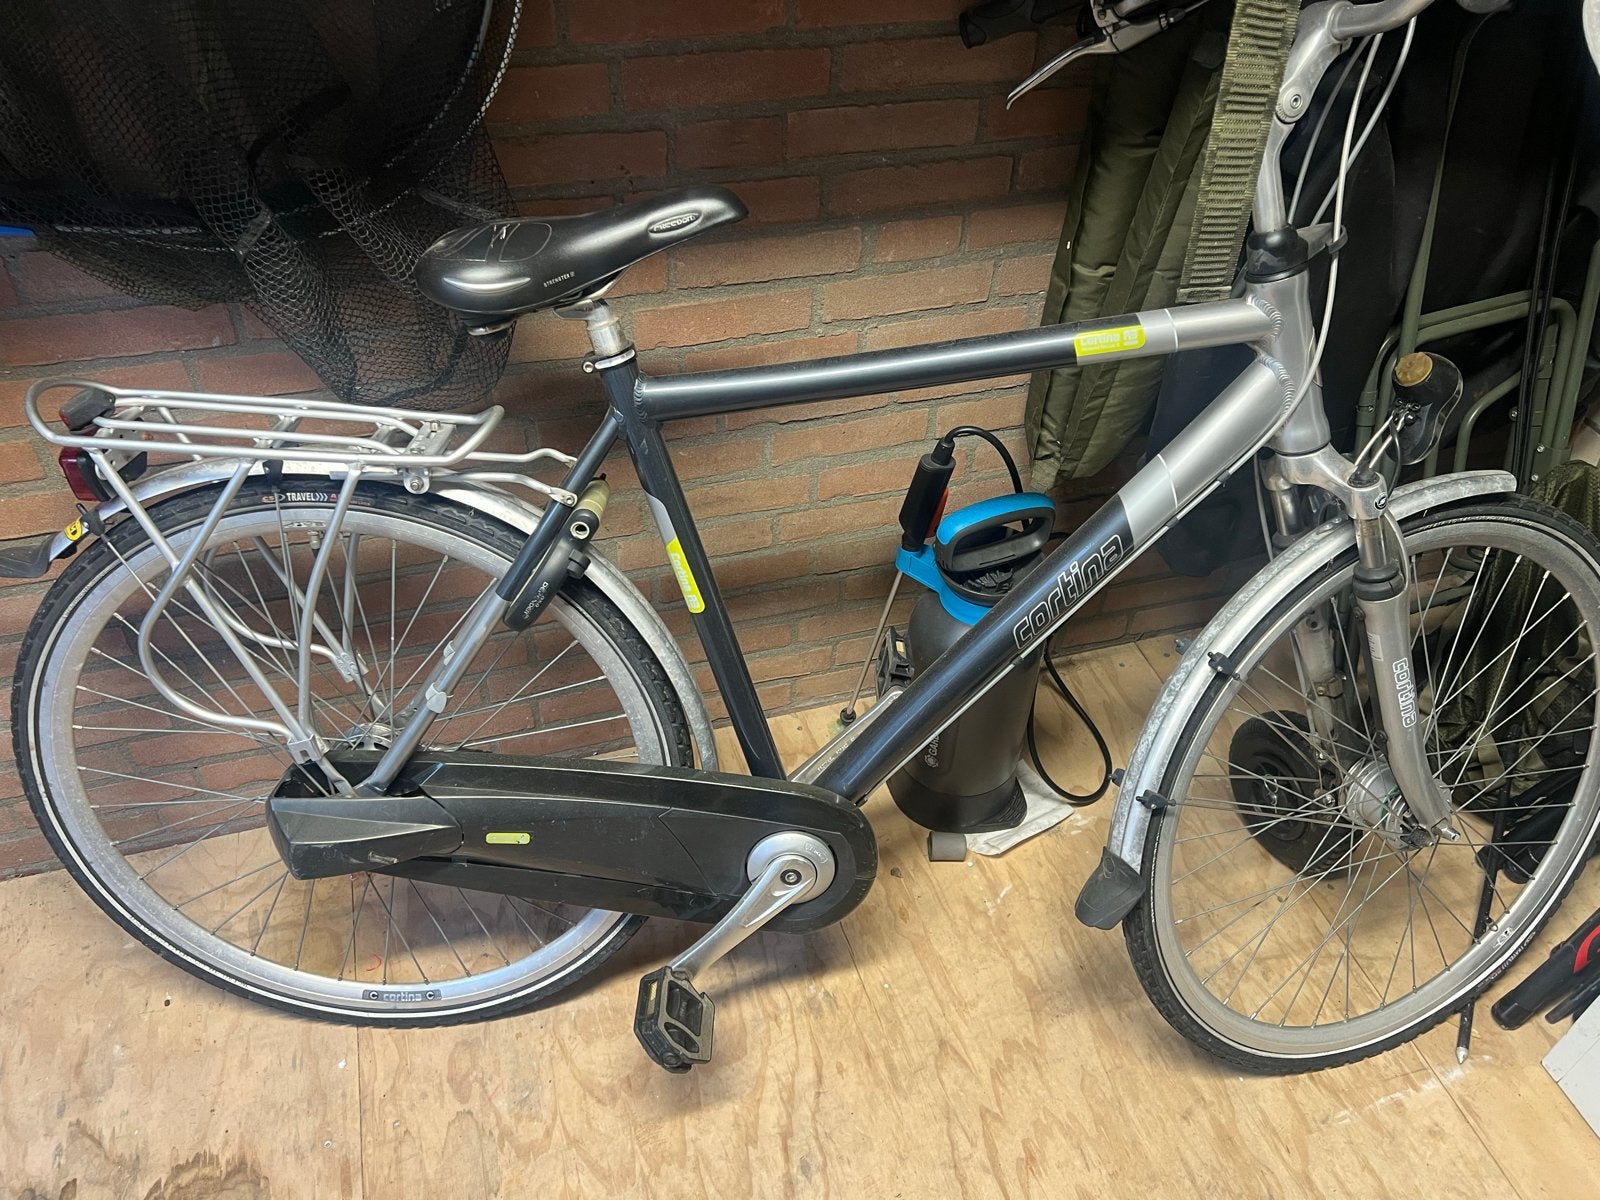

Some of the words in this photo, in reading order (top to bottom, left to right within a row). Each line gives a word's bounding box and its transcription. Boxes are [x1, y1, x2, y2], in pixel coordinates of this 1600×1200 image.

[286, 492, 316, 502] TRAVEL
[1013, 534, 1124, 650] cortina
[1392, 657, 1417, 727] cortina
[383, 992, 422, 1002] cortina
